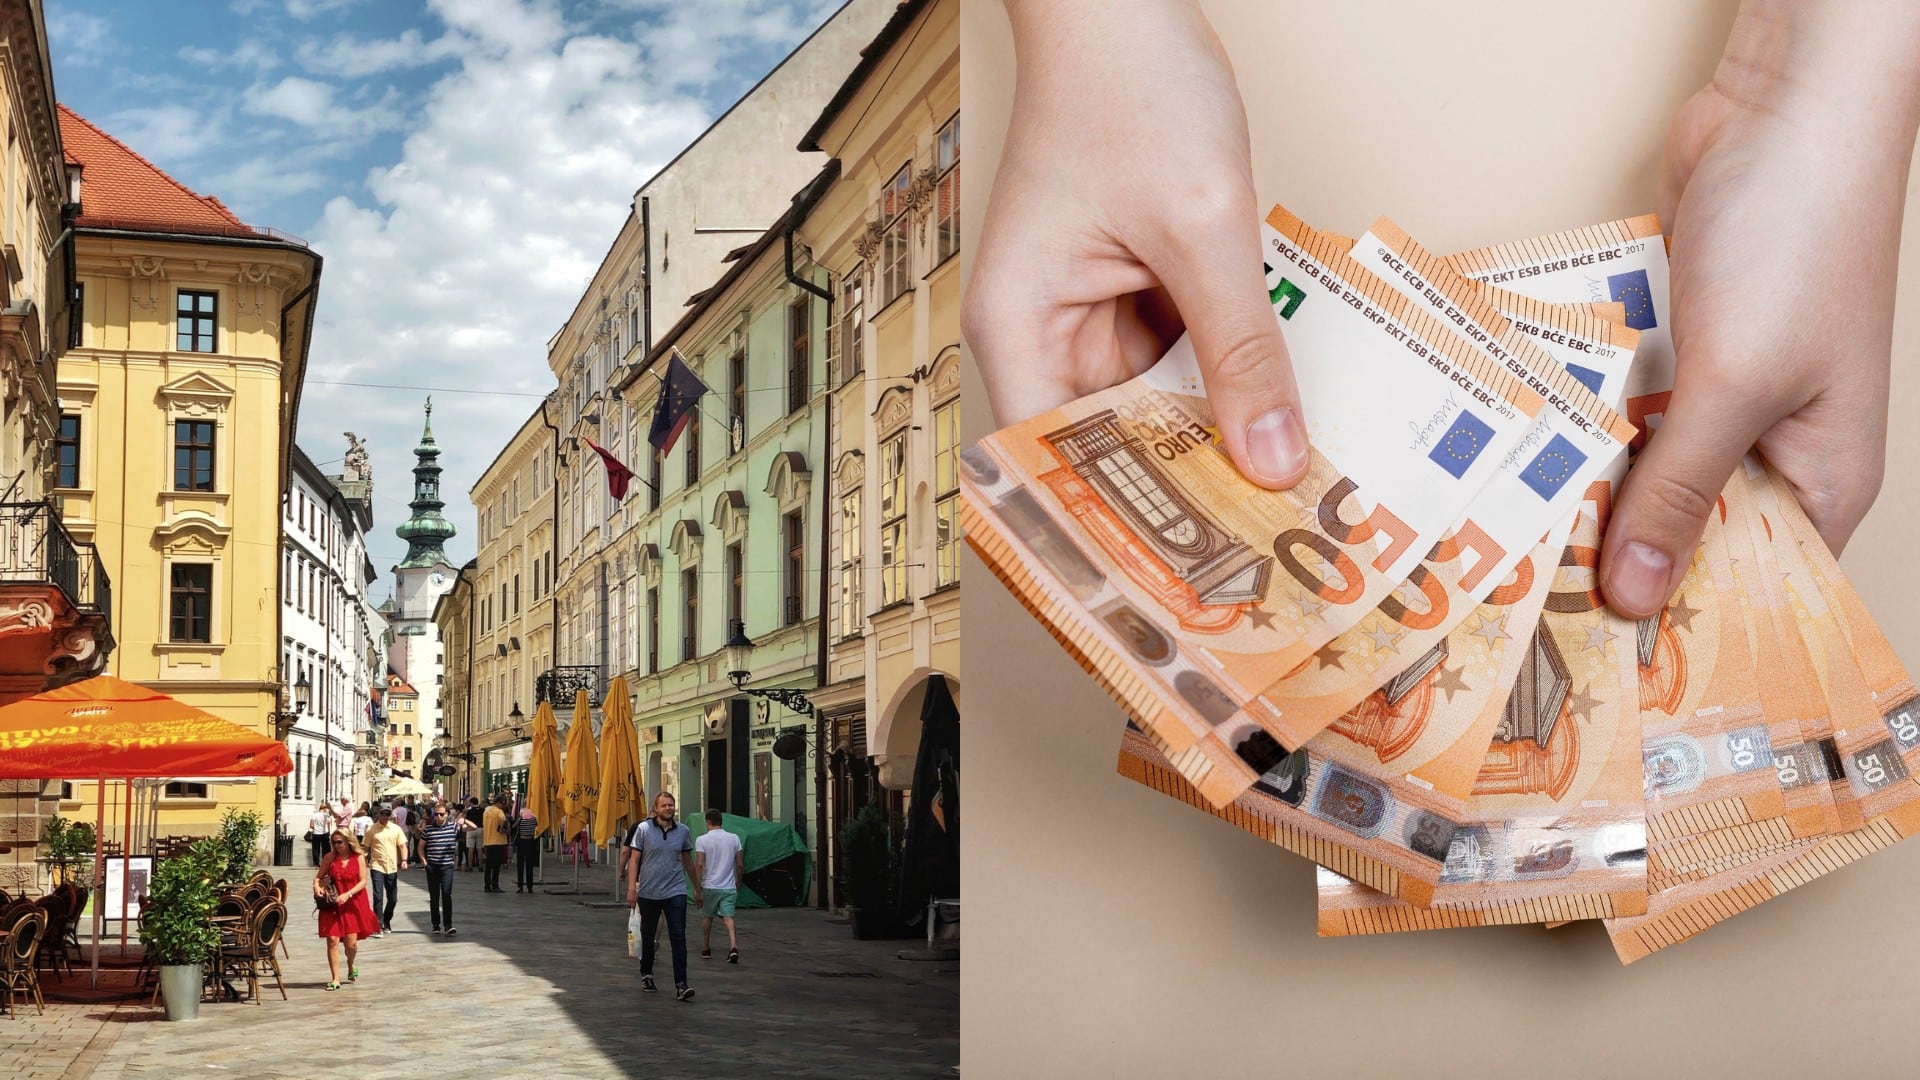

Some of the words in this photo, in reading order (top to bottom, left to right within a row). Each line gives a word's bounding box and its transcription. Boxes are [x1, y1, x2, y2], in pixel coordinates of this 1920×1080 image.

[1493, 270, 1515, 284] EKT
[1518, 265, 1541, 279] ESB
[1544, 260, 1568, 273] EKB
[1598, 248, 1622, 262] EBC
[1625, 243, 1645, 255] 2017
[1298, 258, 1320, 278] ECB
[1341, 291, 1364, 310] EZB
[1362, 306, 1386, 325] EKP
[1384, 322, 1408, 342] EKT
[1406, 338, 1428, 358] ESB
[1427, 354, 1451, 375] EKB
[1472, 387, 1496, 408] EBC
[1495, 404, 1516, 421] 2017
[1402, 270, 1425, 290] ECB
[1444, 306, 1466, 326] EZB
[1464, 323, 1487, 342] EKP
[1485, 341, 1508, 361] EKT
[1505, 358, 1528, 378] ESB
[1526, 376, 1549, 397] EKB
[1569, 411, 1593, 433] EBC
[1592, 429, 1612, 446] 2017
[1515, 321, 1539, 336] EKB
[1567, 338, 1593, 354] EBC
[1594, 346, 1616, 359] 2017
[1153, 422, 1212, 461] EURO
[1273, 476, 1419, 606] 50
[1890, 712, 1918, 741] 50
[1730, 737, 1755, 766] 50
[1774, 754, 1799, 783] 50
[1857, 754, 1886, 783] 50
